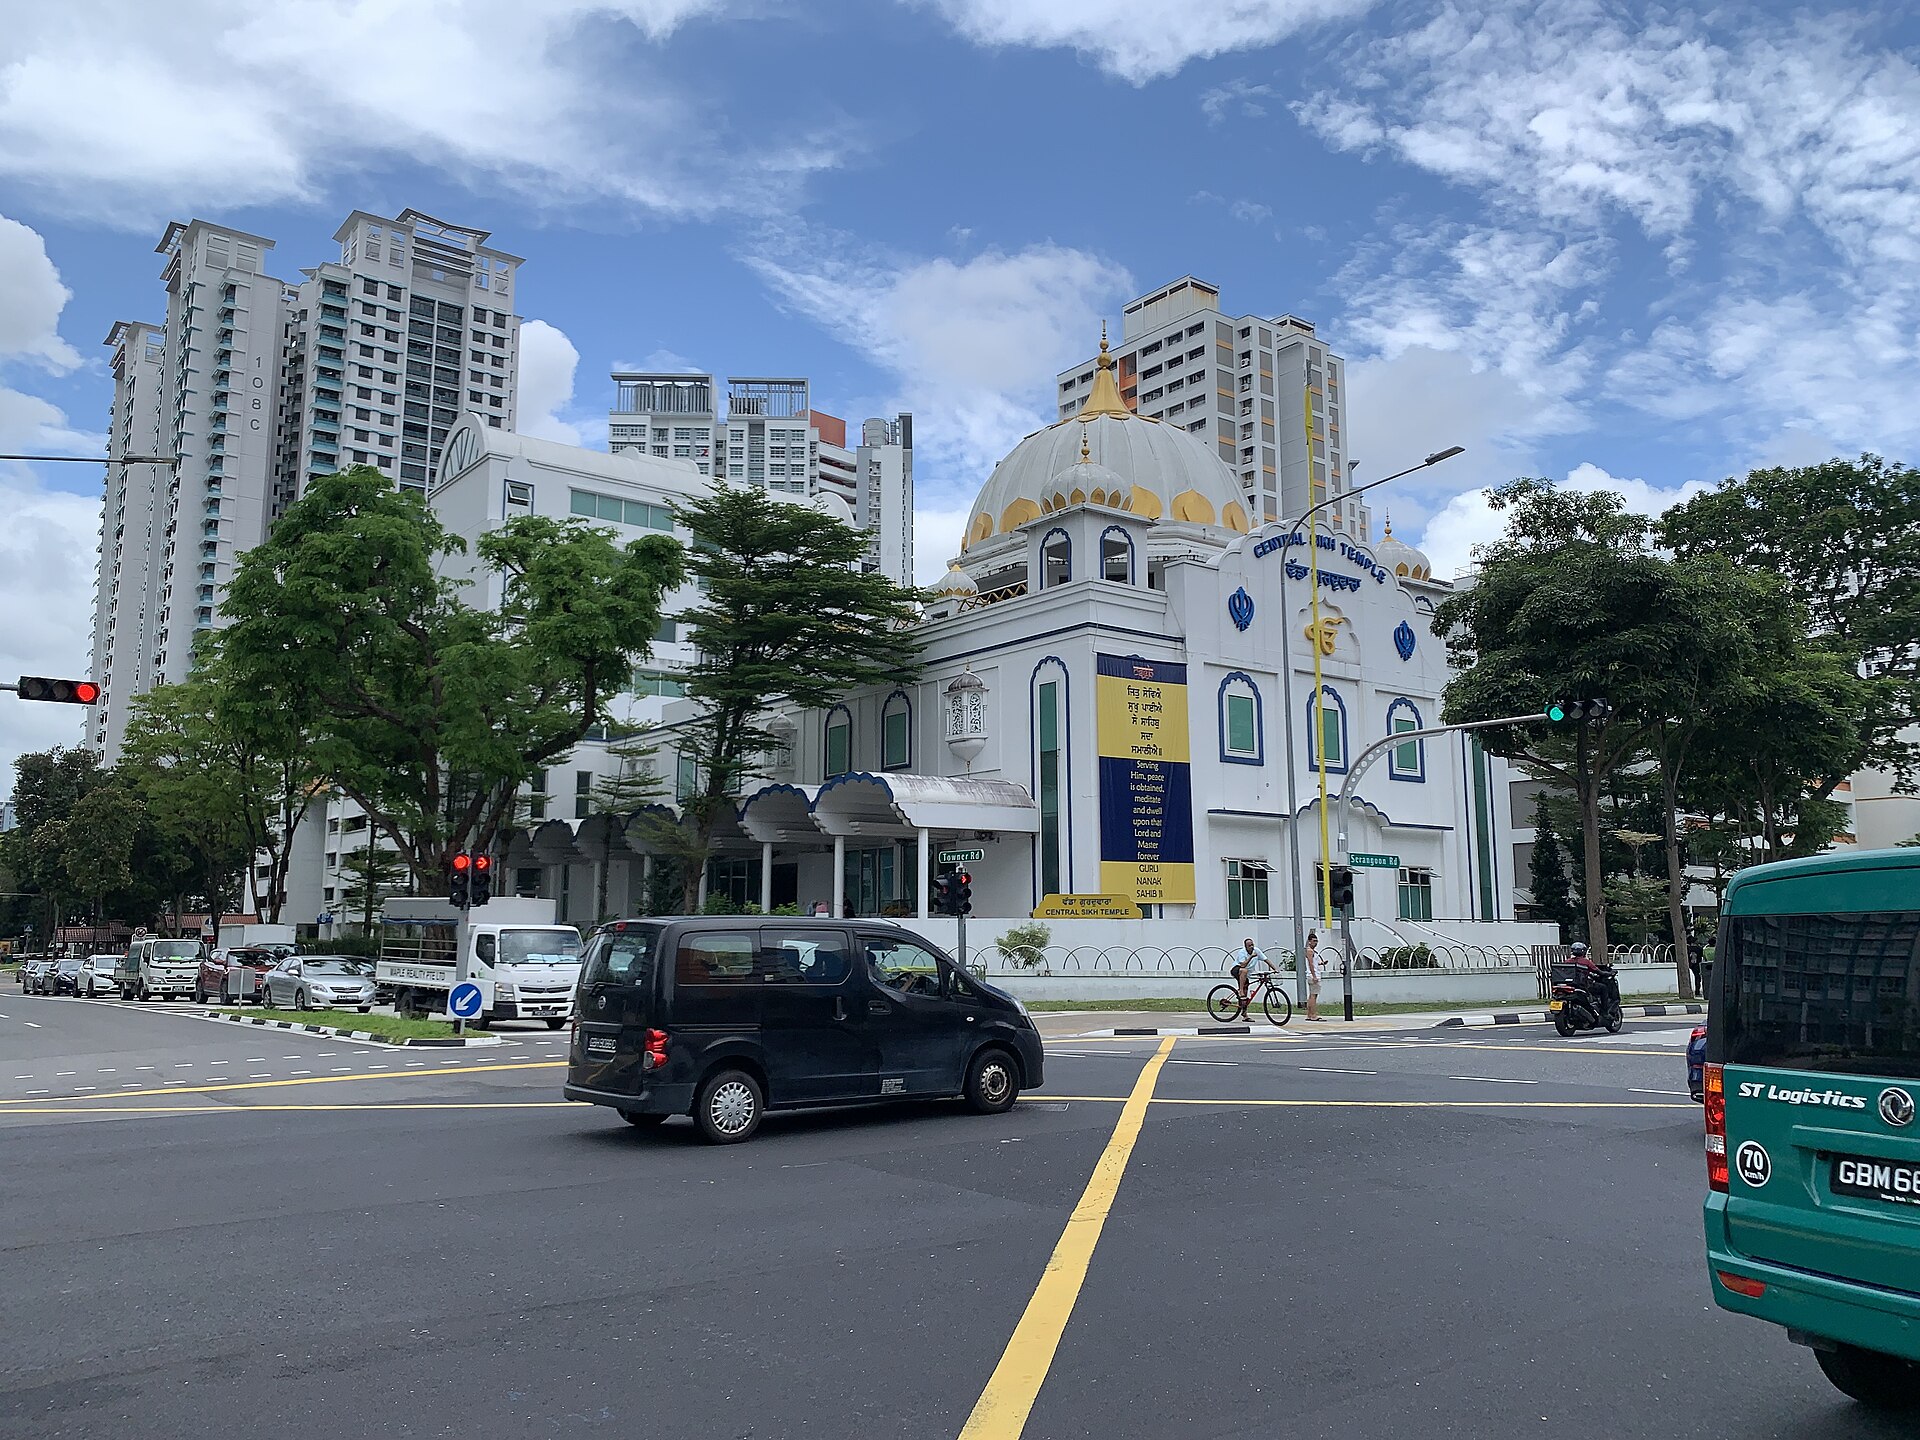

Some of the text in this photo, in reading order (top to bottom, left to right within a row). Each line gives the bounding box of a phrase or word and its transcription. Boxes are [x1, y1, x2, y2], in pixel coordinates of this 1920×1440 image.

[250, 356, 263, 431] 108C
[1253, 532, 1306, 559] CENTRAL
[1340, 542, 1386, 585] TEMPLE
[1137, 760, 1159, 771] Serving
[1147, 774, 1165, 782] peace
[1130, 783, 1136, 791] is
[1135, 795, 1161, 803] meditate
[1133, 806, 1162, 815] and dwell
[1133, 818, 1162, 827] upon that
[1134, 829, 1161, 838] Lord and
[1137, 841, 1158, 849] Master
[943, 851, 980, 861] Towner Rd
[1137, 852, 1159, 860] forever
[1350, 854, 1398, 866] Serangoon Rd
[1139, 864, 1159, 873] GURU
[1136, 877, 1162, 885] NANAK
[1136, 889, 1157, 898] SAHIB
[1101, 908, 1129, 916] TEMPLE
[1738, 1082, 1868, 1109] ST Logistics
[1743, 1149, 1764, 1171] 70
[1744, 1169, 1765, 1181] km/h
